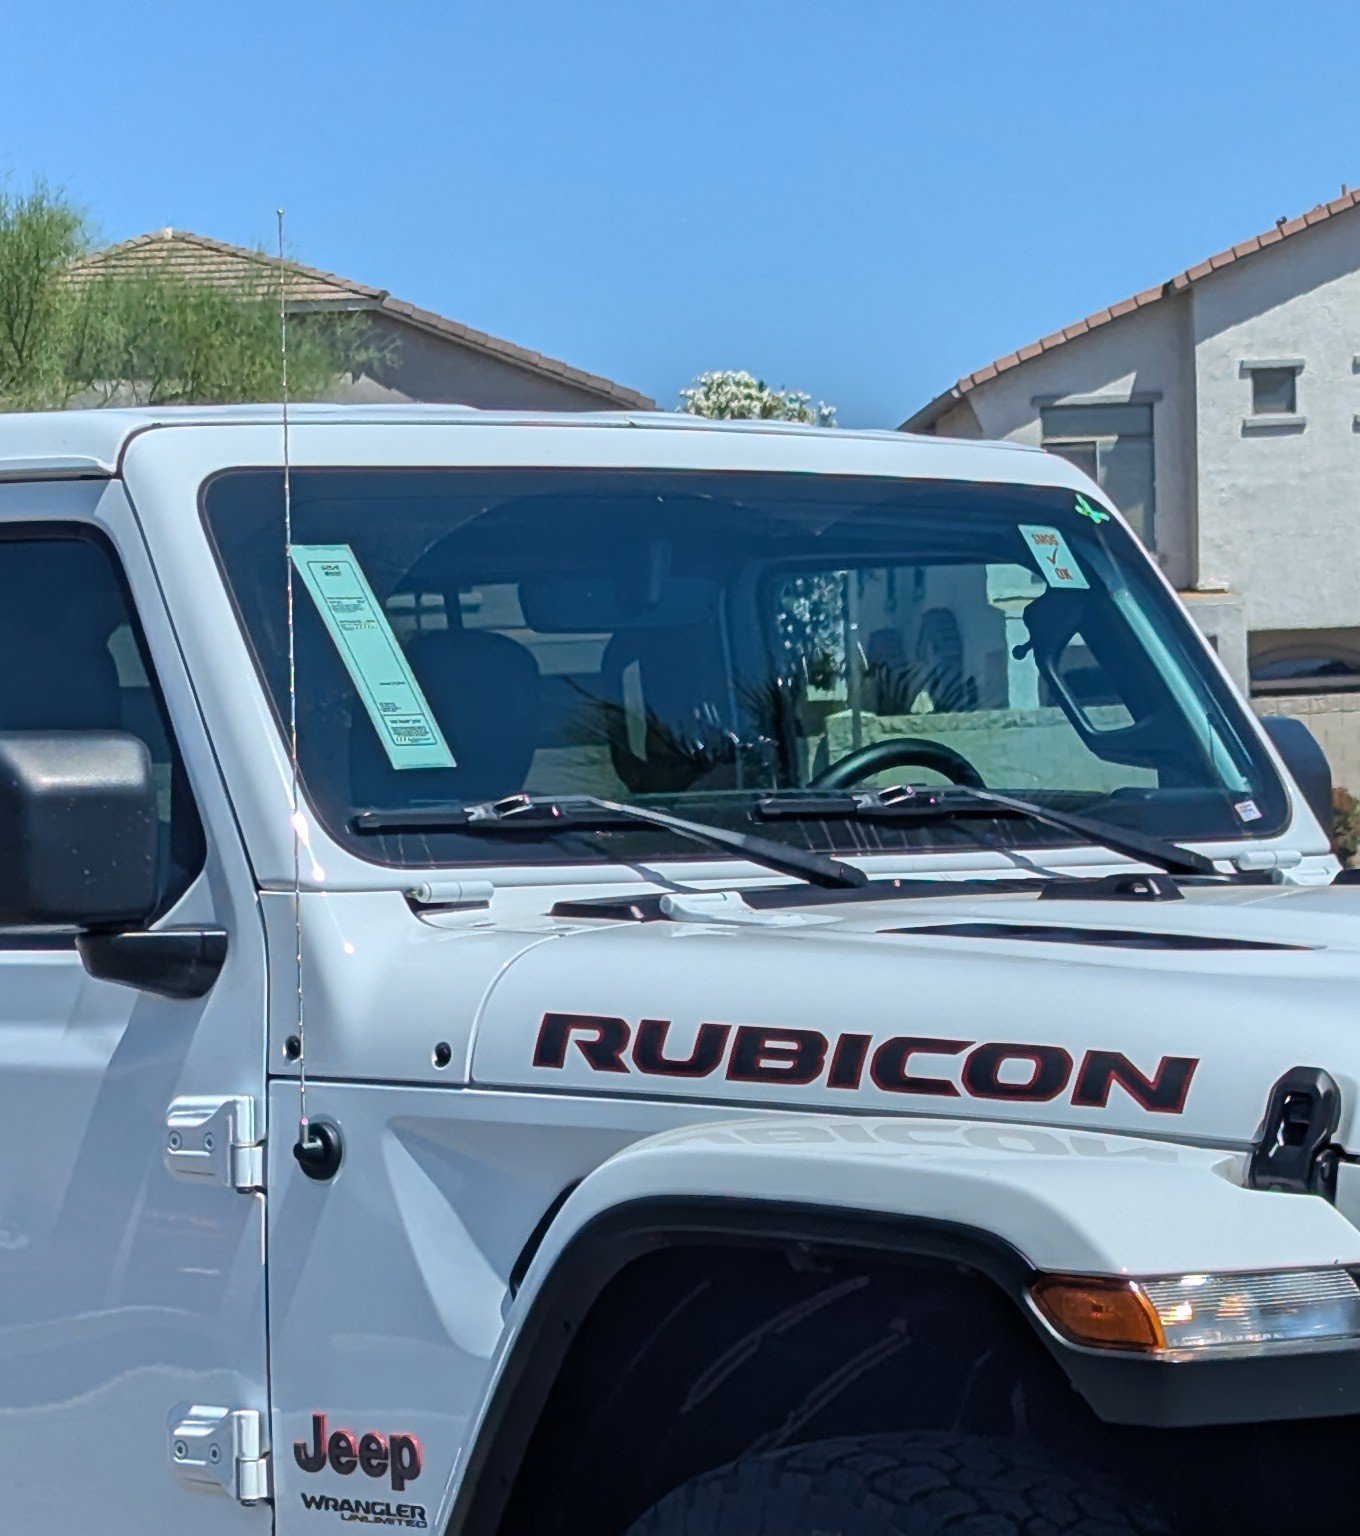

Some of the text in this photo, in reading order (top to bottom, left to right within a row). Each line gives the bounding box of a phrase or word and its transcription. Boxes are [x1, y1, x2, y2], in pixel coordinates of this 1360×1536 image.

[1054, 567, 1073, 581] OK
[532, 1011, 1200, 1115] RUBICON
[293, 1410, 425, 1492] Jeep
[300, 1492, 426, 1520] WRANGLER
[340, 1513, 428, 1529] UNLIMITED
